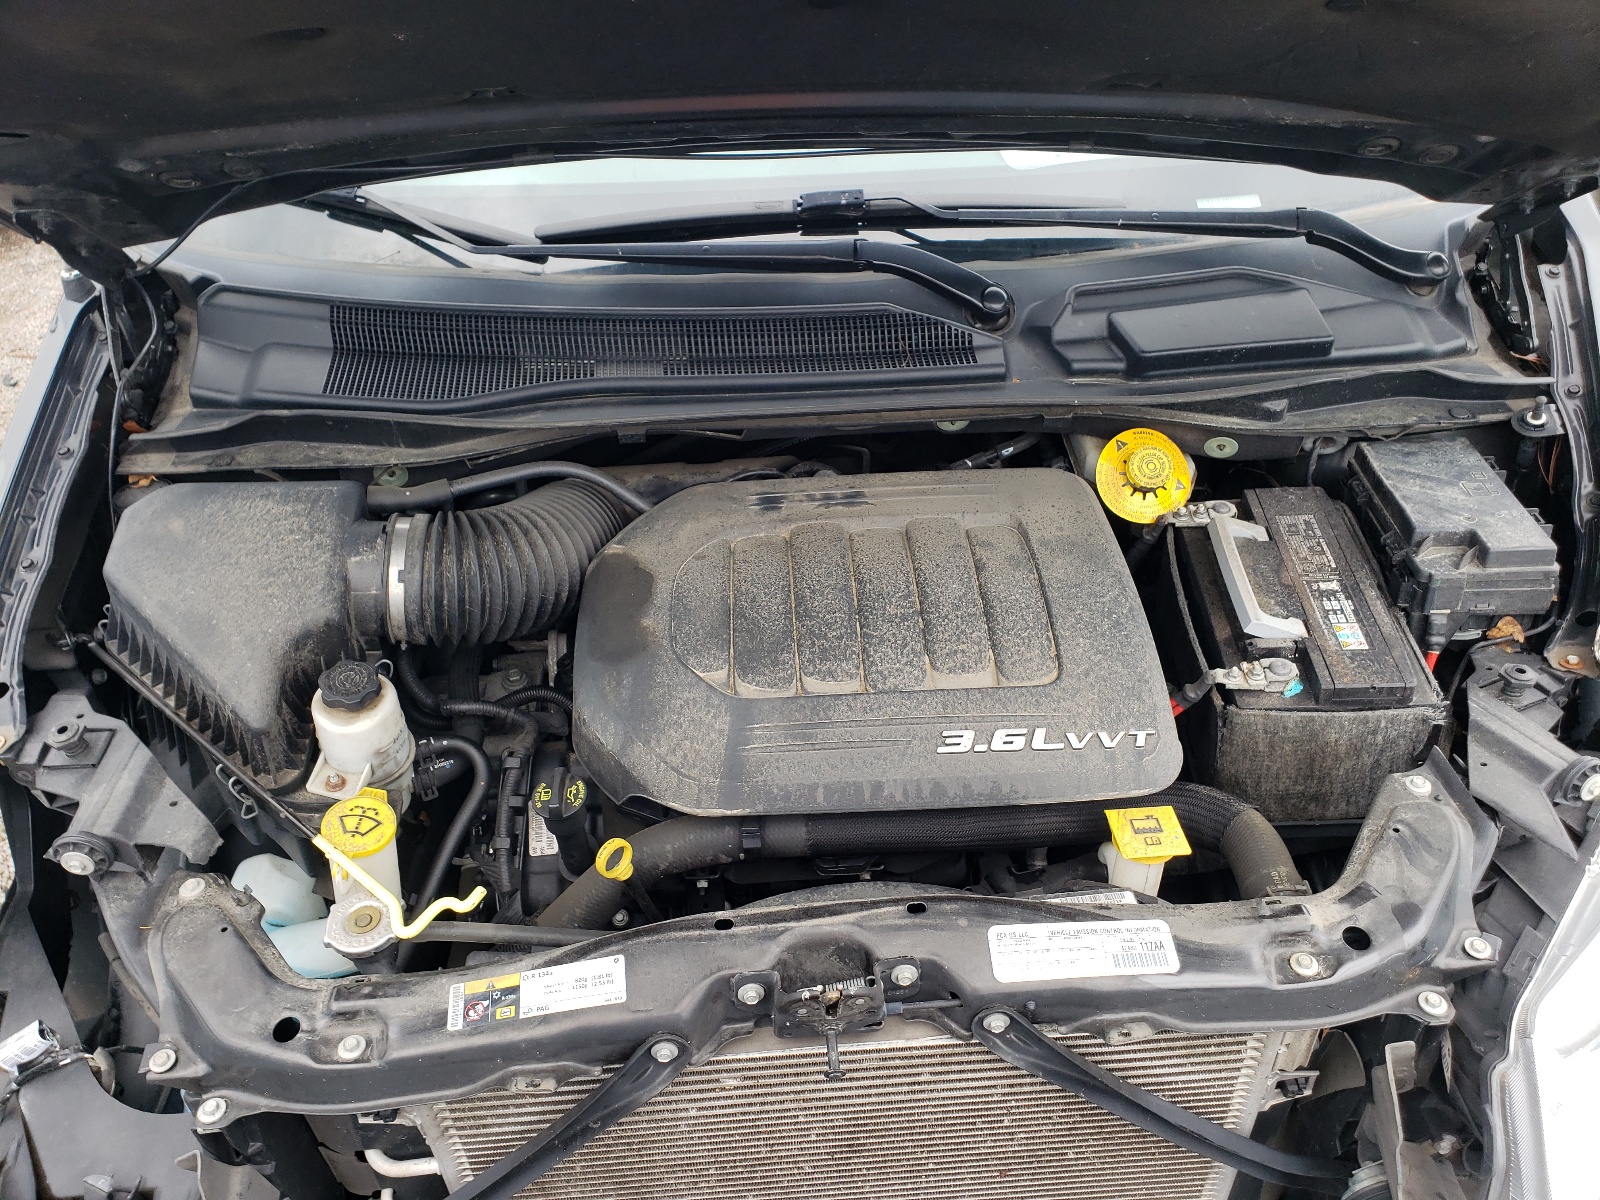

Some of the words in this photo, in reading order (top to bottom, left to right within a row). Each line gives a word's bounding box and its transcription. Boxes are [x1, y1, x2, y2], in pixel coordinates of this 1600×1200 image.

[576, 780, 586, 798] ENGINE
[572, 798, 583, 807] OIL
[1124, 926, 1161, 934] INFORMATION
[536, 1005, 550, 1013] PAG
